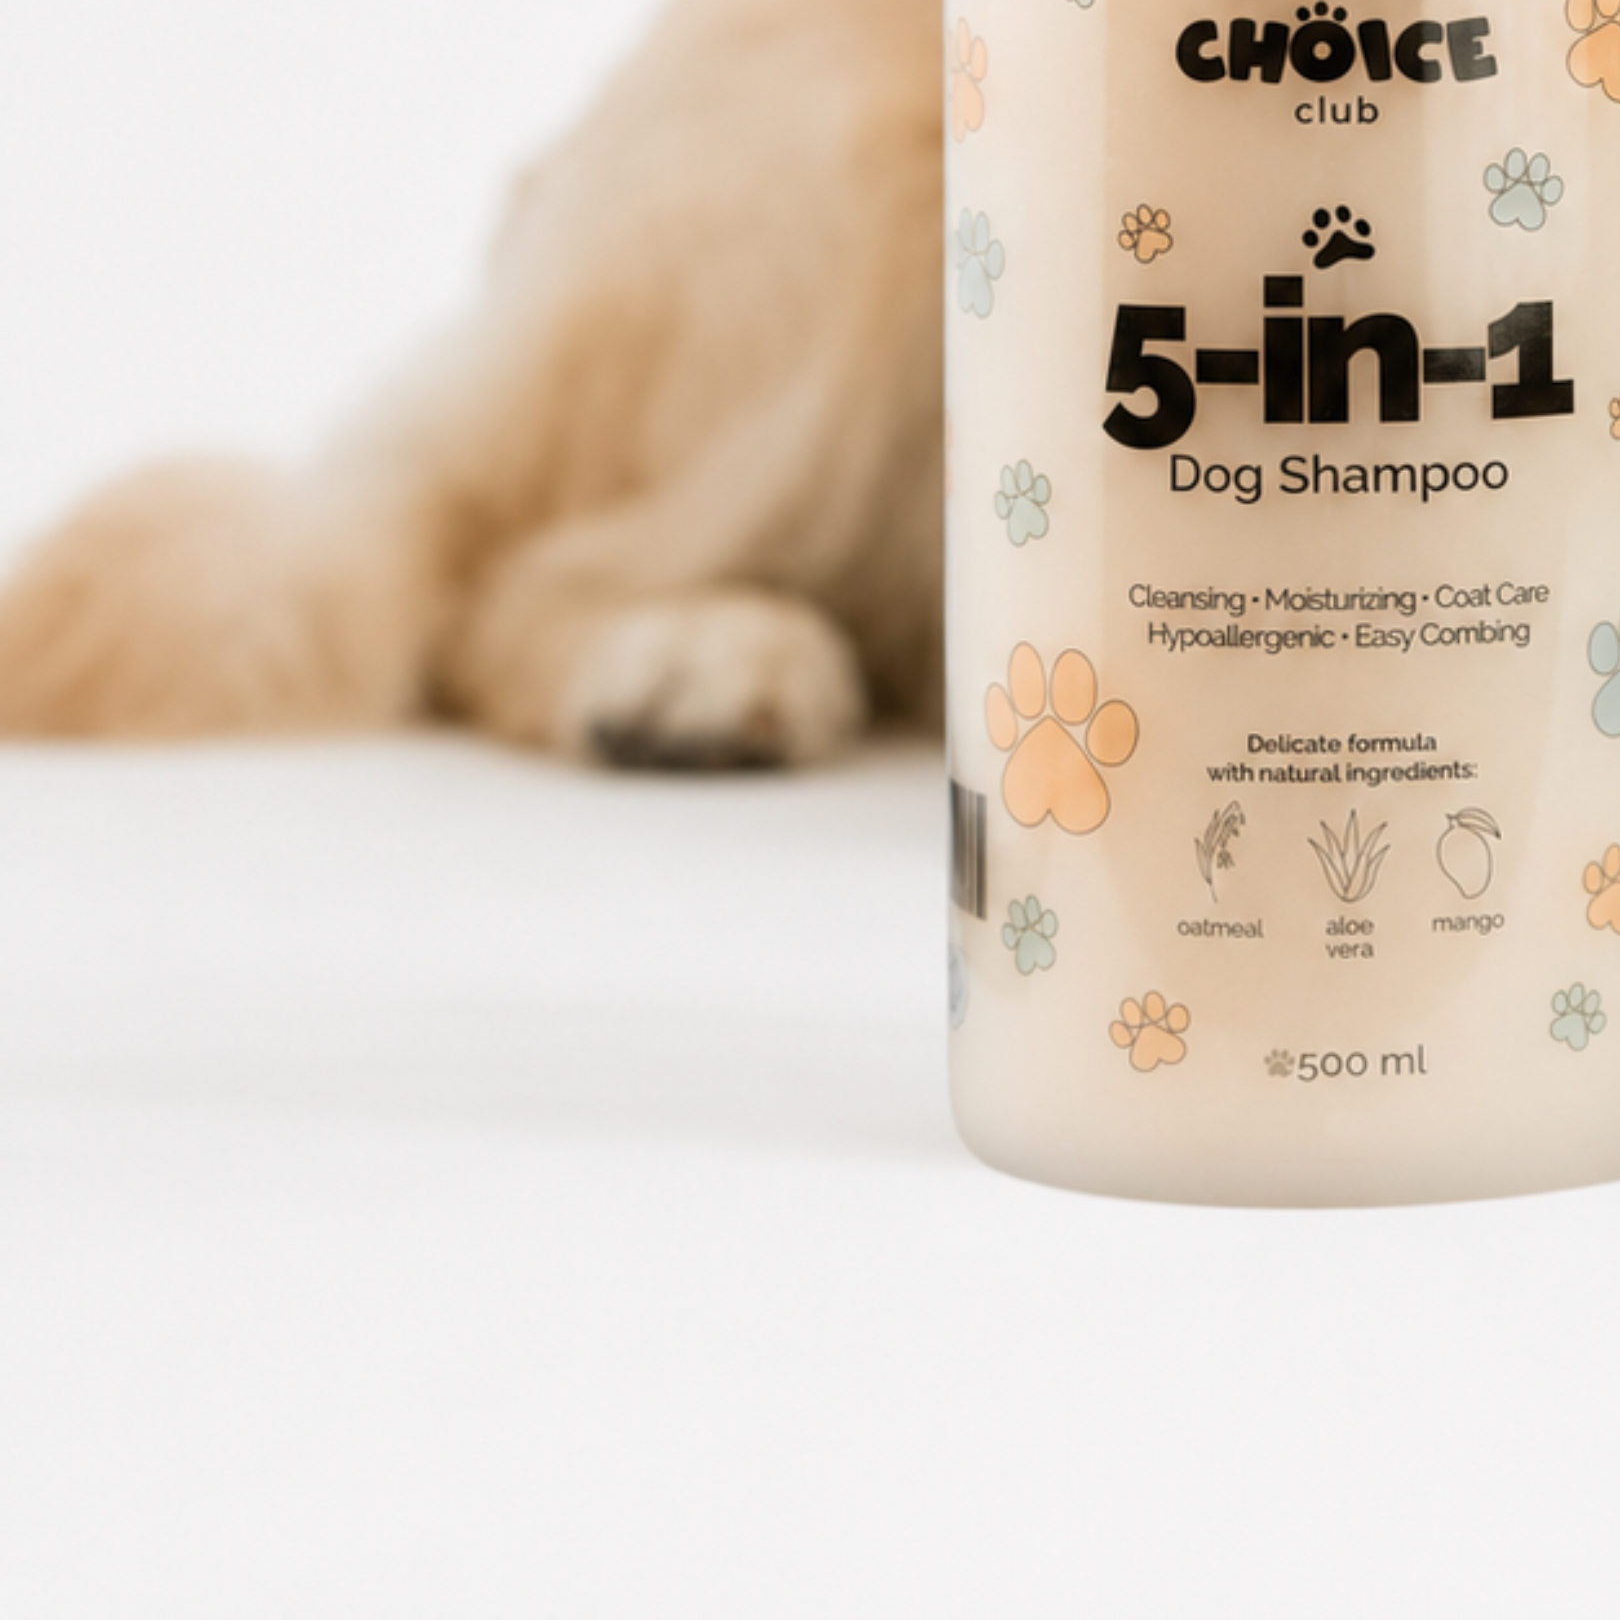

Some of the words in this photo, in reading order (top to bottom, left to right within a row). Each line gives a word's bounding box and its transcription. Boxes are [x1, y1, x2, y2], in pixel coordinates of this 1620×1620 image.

[1175, 16, 1498, 84] CHOICE
[1293, 94, 1380, 125] club
[1102, 274, 1575, 450] 5-in-1
[1169, 454, 1263, 505] Dog
[1278, 453, 1509, 504] Shampoo
[1128, 583, 1247, 616] Cleansing
[1264, 587, 1417, 616] Moisturizing
[1434, 583, 1492, 609] Coat
[1495, 581, 1550, 606] Care
[1148, 622, 1336, 654] Hypoallergenic
[1355, 622, 1417, 654] Easy
[1418, 619, 1531, 648] Combing
[1246, 733, 1343, 756] Delicate
[1347, 732, 1438, 755] formula
[1206, 761, 1255, 784] with
[1258, 762, 1343, 784] natural
[1345, 760, 1478, 788] ingredients:
[1176, 917, 1265, 939] oatmeal
[1324, 914, 1375, 937] aloe
[1431, 913, 1505, 936] mango
[1324, 941, 1375, 960] vera
[1297, 1051, 1369, 1083] 500
[1380, 1044, 1427, 1076] ml
